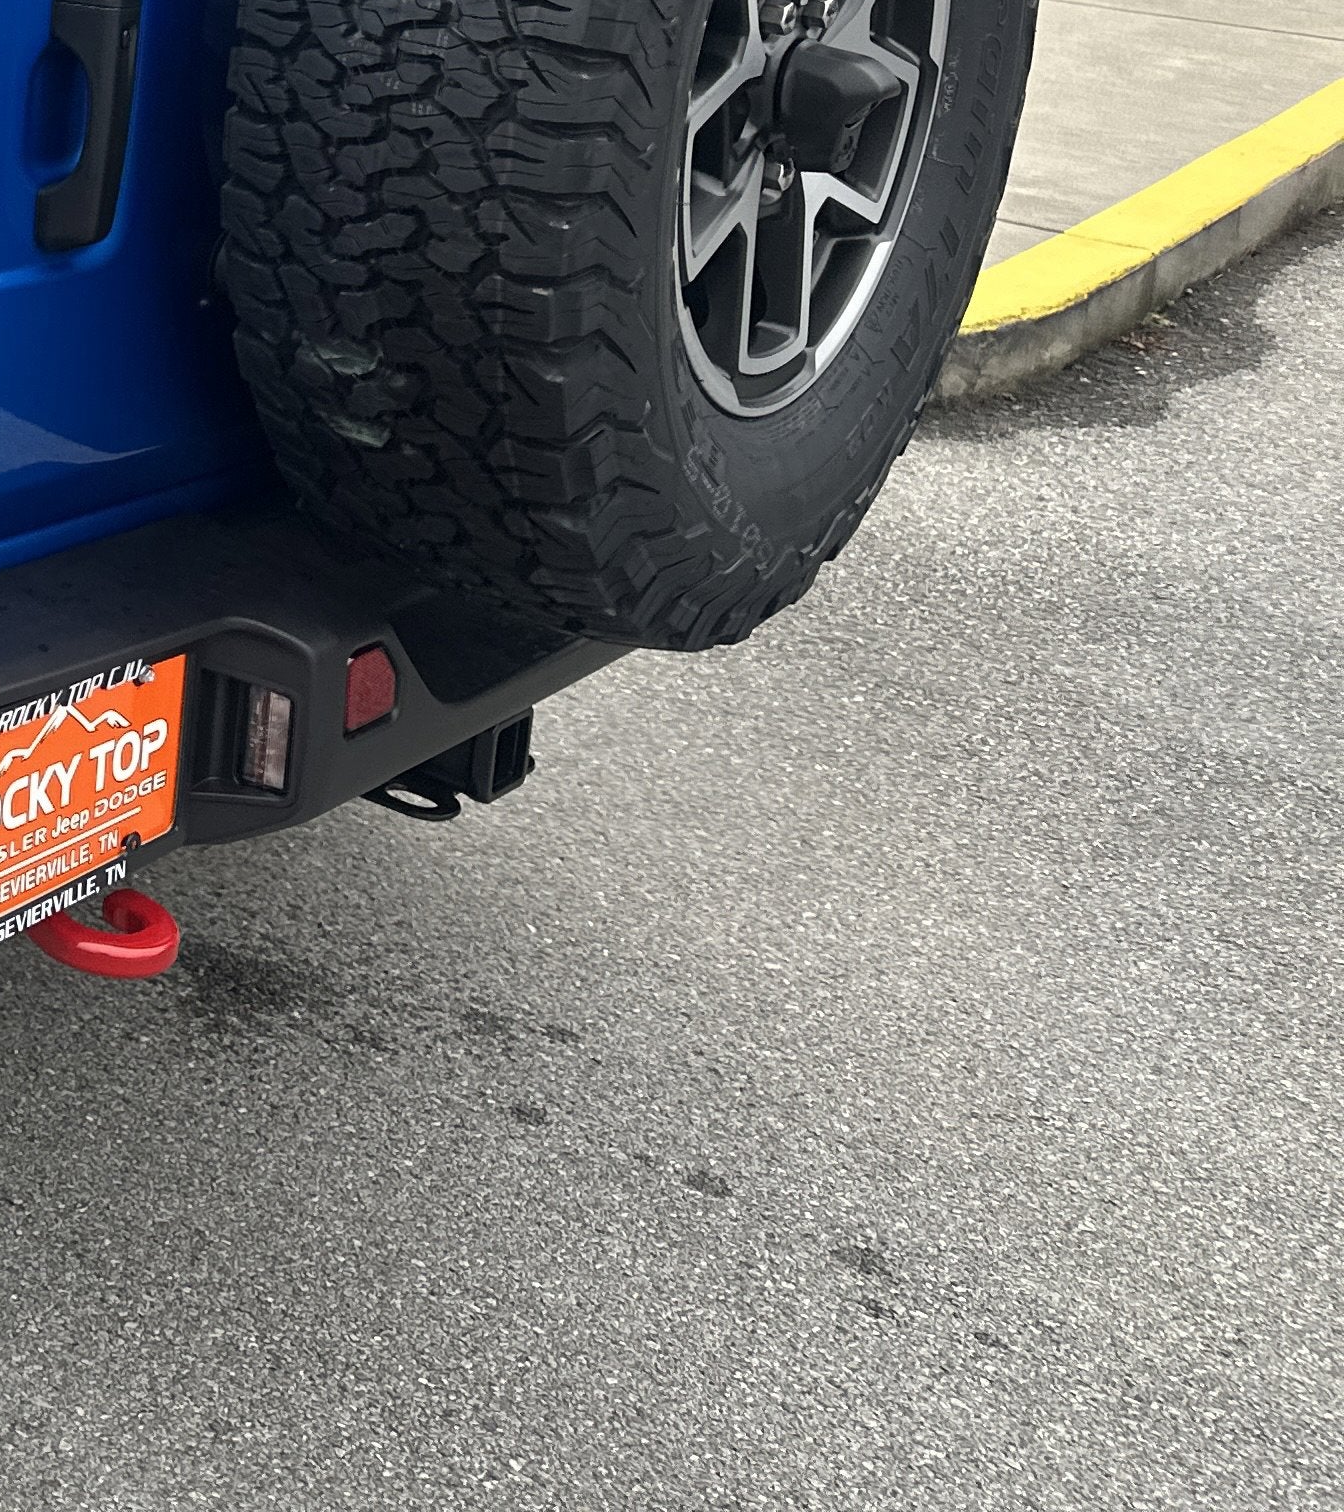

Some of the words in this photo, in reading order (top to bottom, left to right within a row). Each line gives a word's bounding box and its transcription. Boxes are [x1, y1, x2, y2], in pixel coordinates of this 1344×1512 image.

[66, 672, 105, 707] TOP
[89, 718, 169, 793] TOP
[51, 809, 89, 840] Jeep
[94, 770, 168, 818] DODGE
[99, 829, 121, 854] TN
[105, 859, 127, 887] TN
